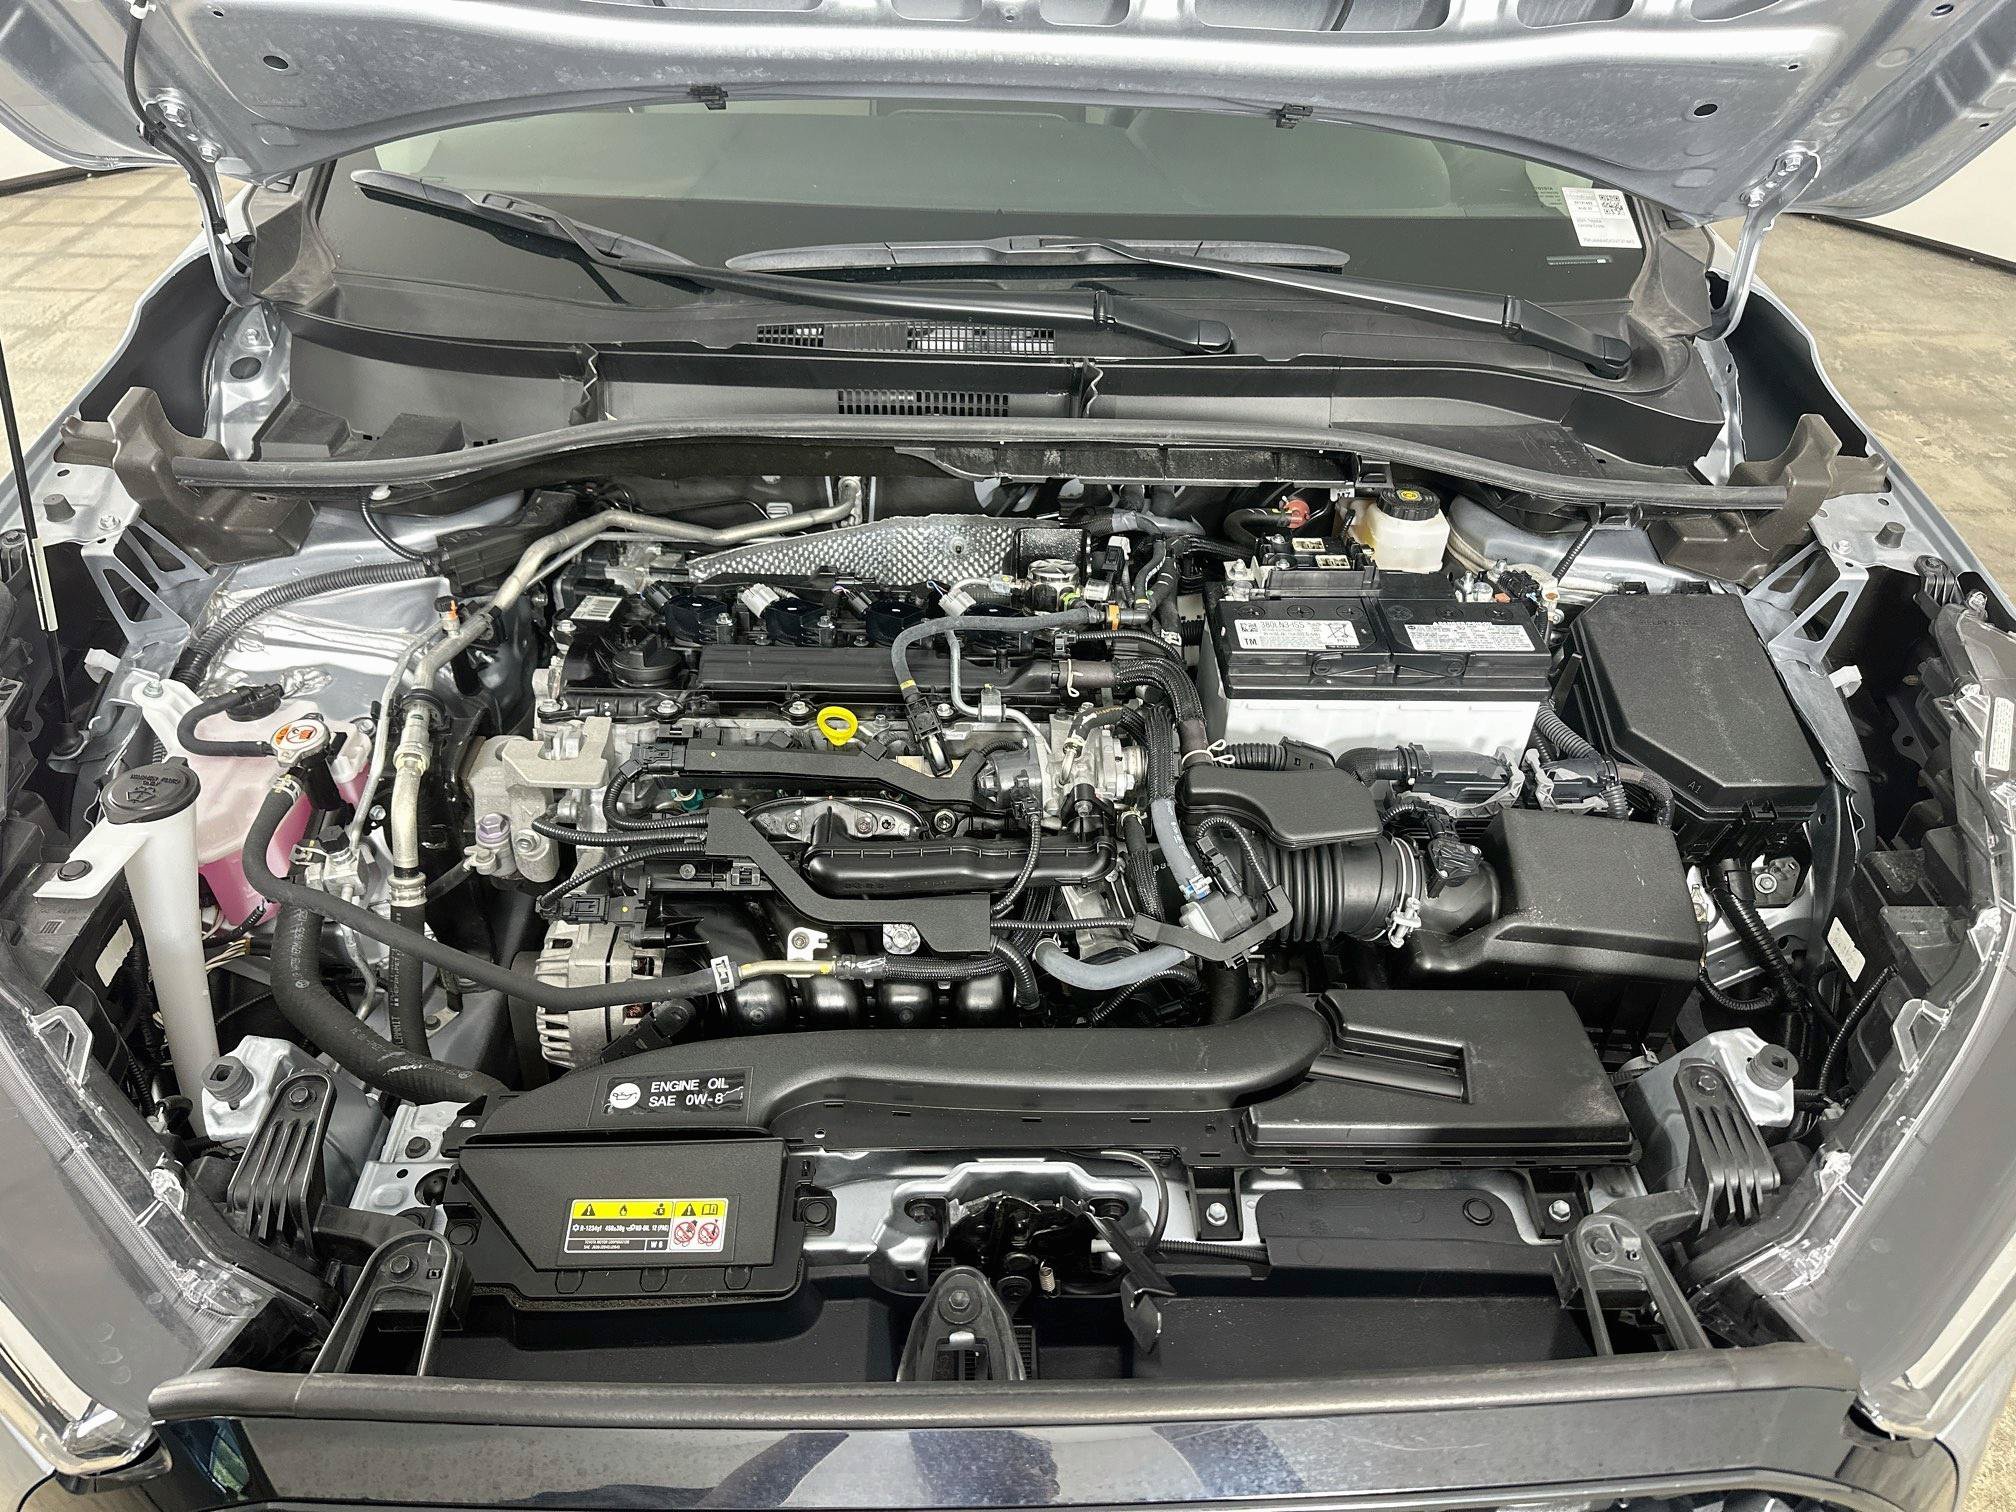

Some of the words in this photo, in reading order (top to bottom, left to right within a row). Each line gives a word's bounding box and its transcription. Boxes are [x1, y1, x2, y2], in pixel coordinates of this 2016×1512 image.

[1244, 638, 1257, 646] TM
[650, 1079, 700, 1093] ENGINE
[707, 1077, 730, 1090] OIL
[648, 1094, 677, 1107] SAE
[685, 1092, 724, 1106] 0W-8
